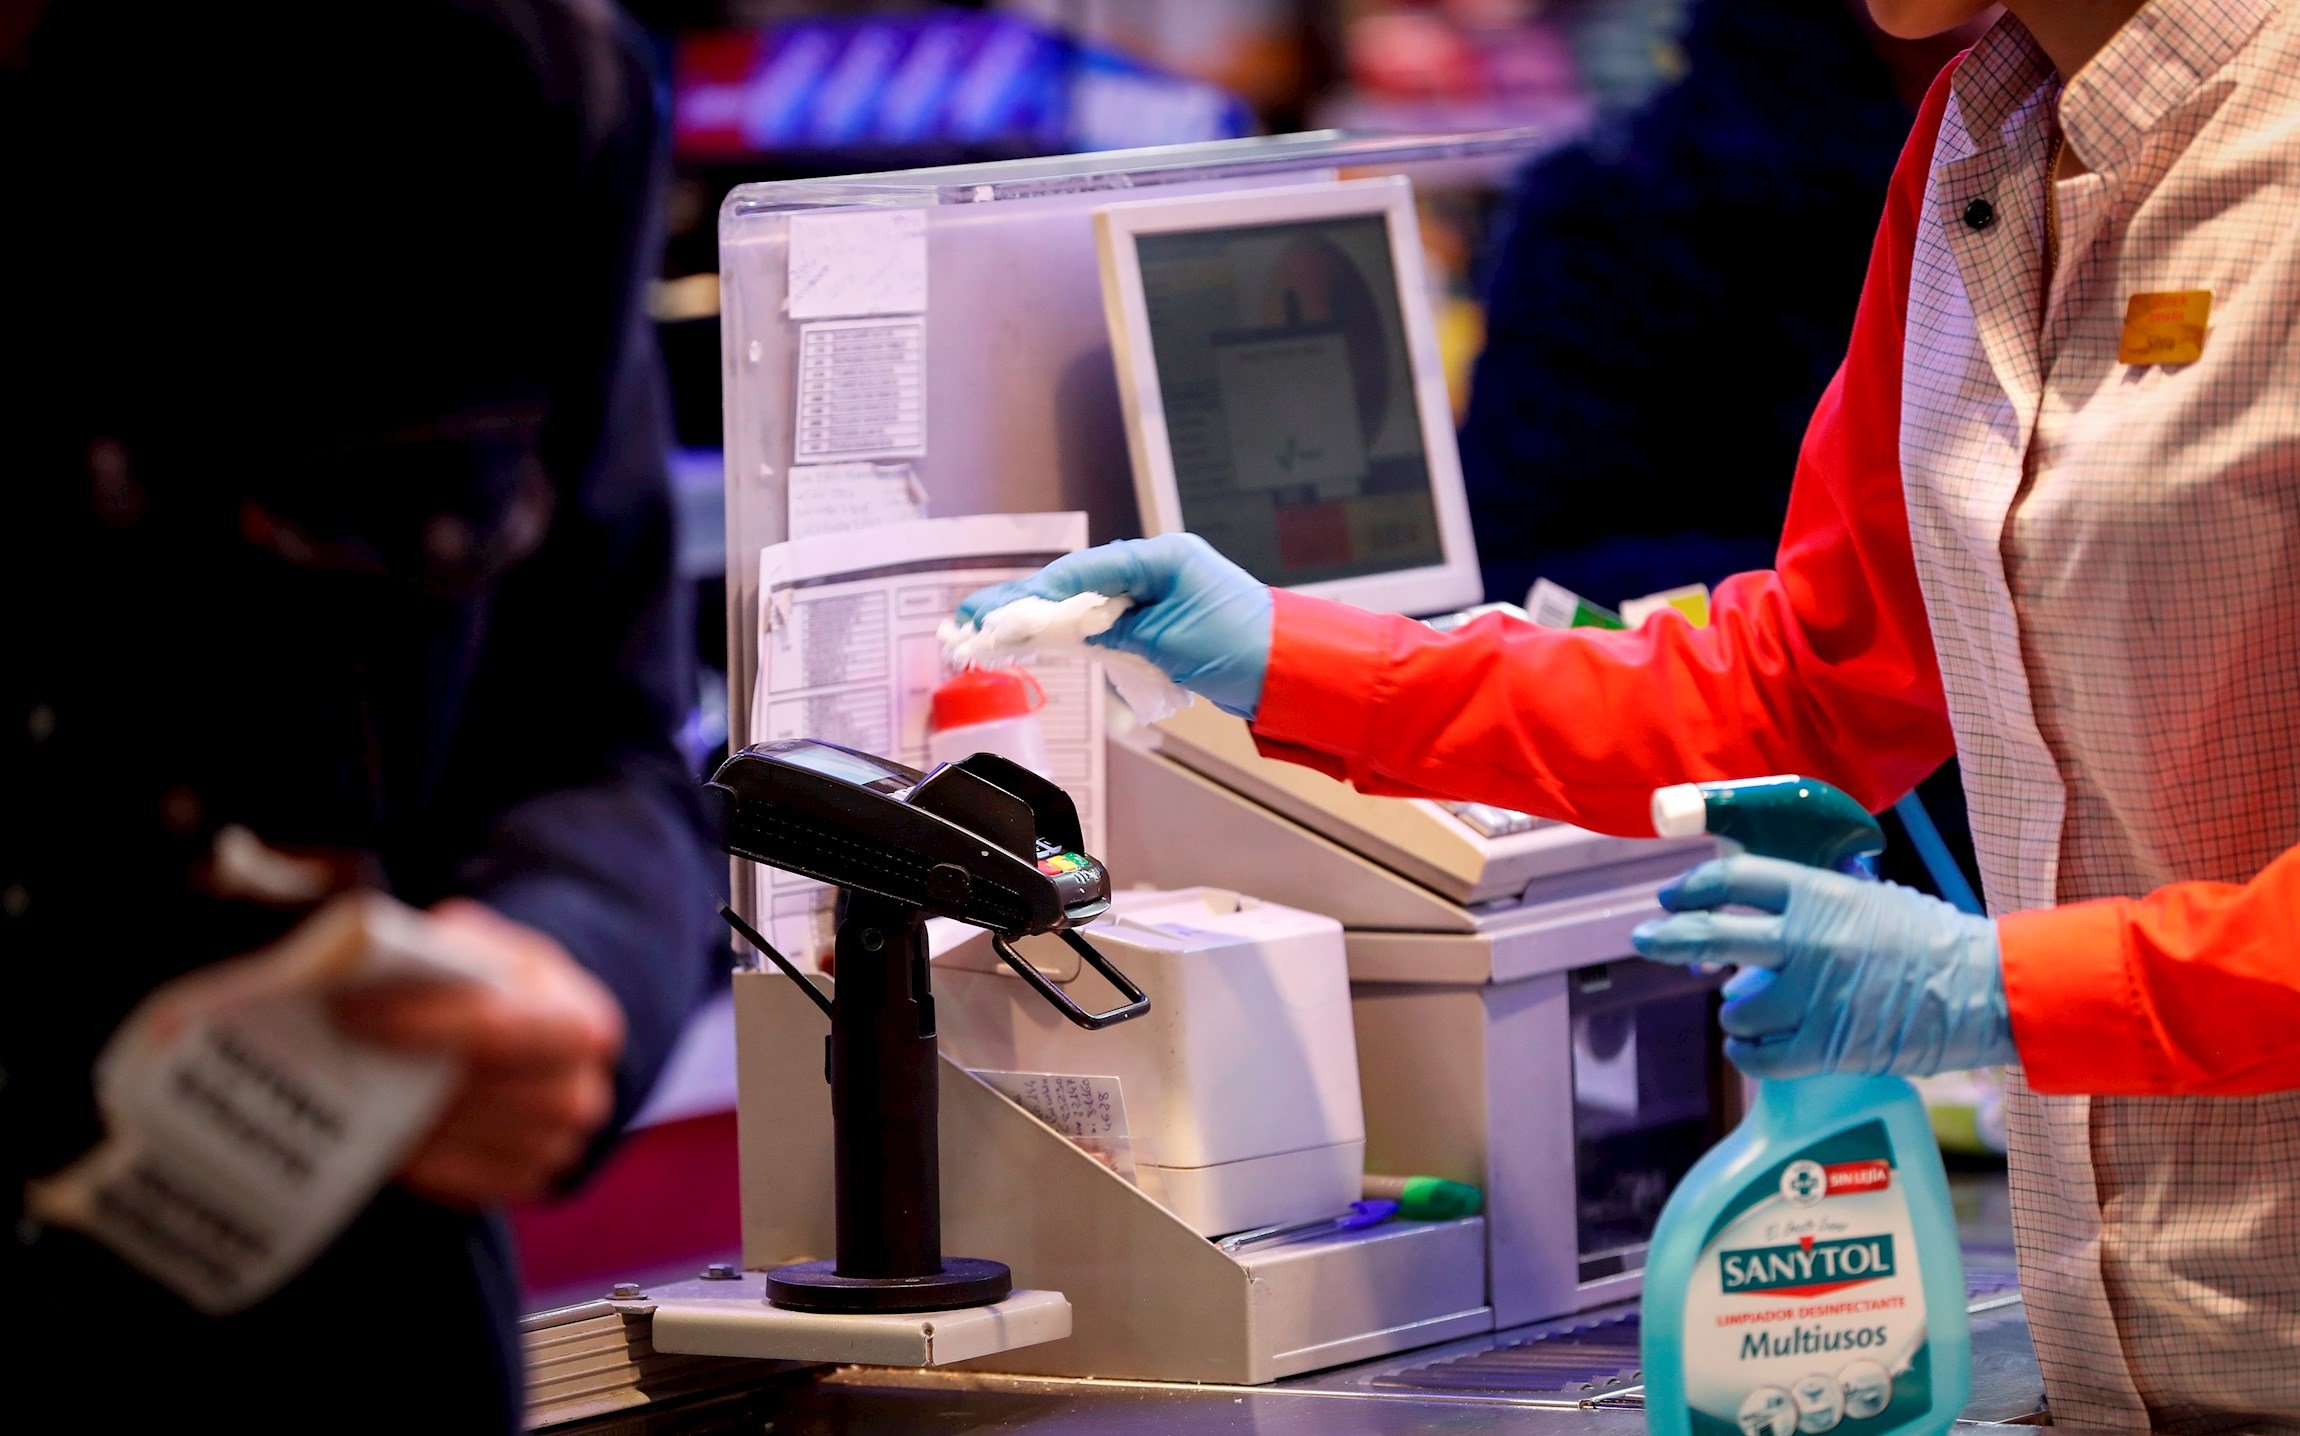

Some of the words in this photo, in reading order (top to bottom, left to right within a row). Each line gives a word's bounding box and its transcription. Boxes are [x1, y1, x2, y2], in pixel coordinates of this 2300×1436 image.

[1724, 1243, 1890, 1286] SANYTOL
[1717, 1309, 1795, 1327] LIMPIADOR
[1799, 1297, 1906, 1318] DESINFECTANTE
[1740, 1323, 1887, 1361] Multiusos
